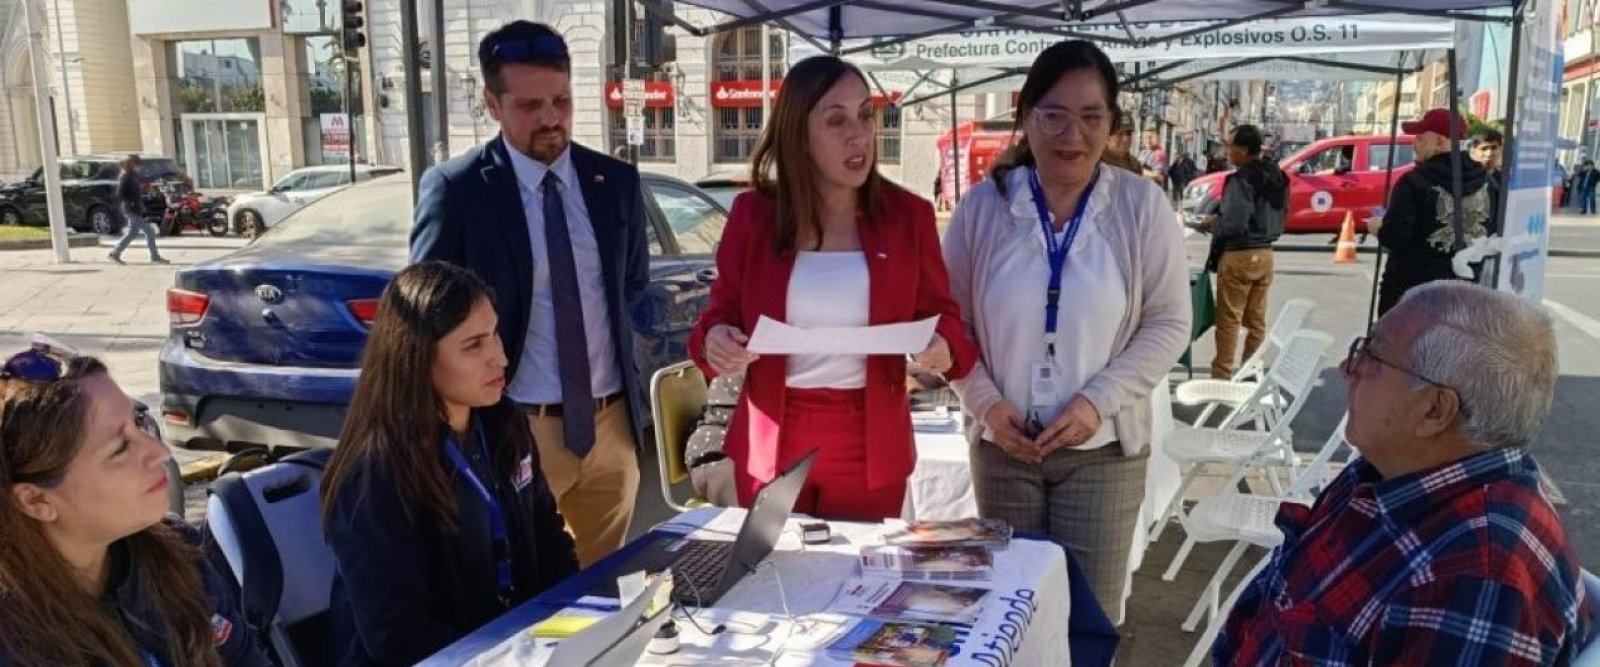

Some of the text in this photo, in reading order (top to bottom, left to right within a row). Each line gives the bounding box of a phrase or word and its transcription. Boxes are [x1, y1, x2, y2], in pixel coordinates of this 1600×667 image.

[916, 39, 1000, 58] Prefectura
[1005, 37, 1053, 55] Contr
[1181, 27, 1284, 48] Explosivos
[1291, 26, 1331, 43] O.S.
[1339, 24, 1358, 40] 11
